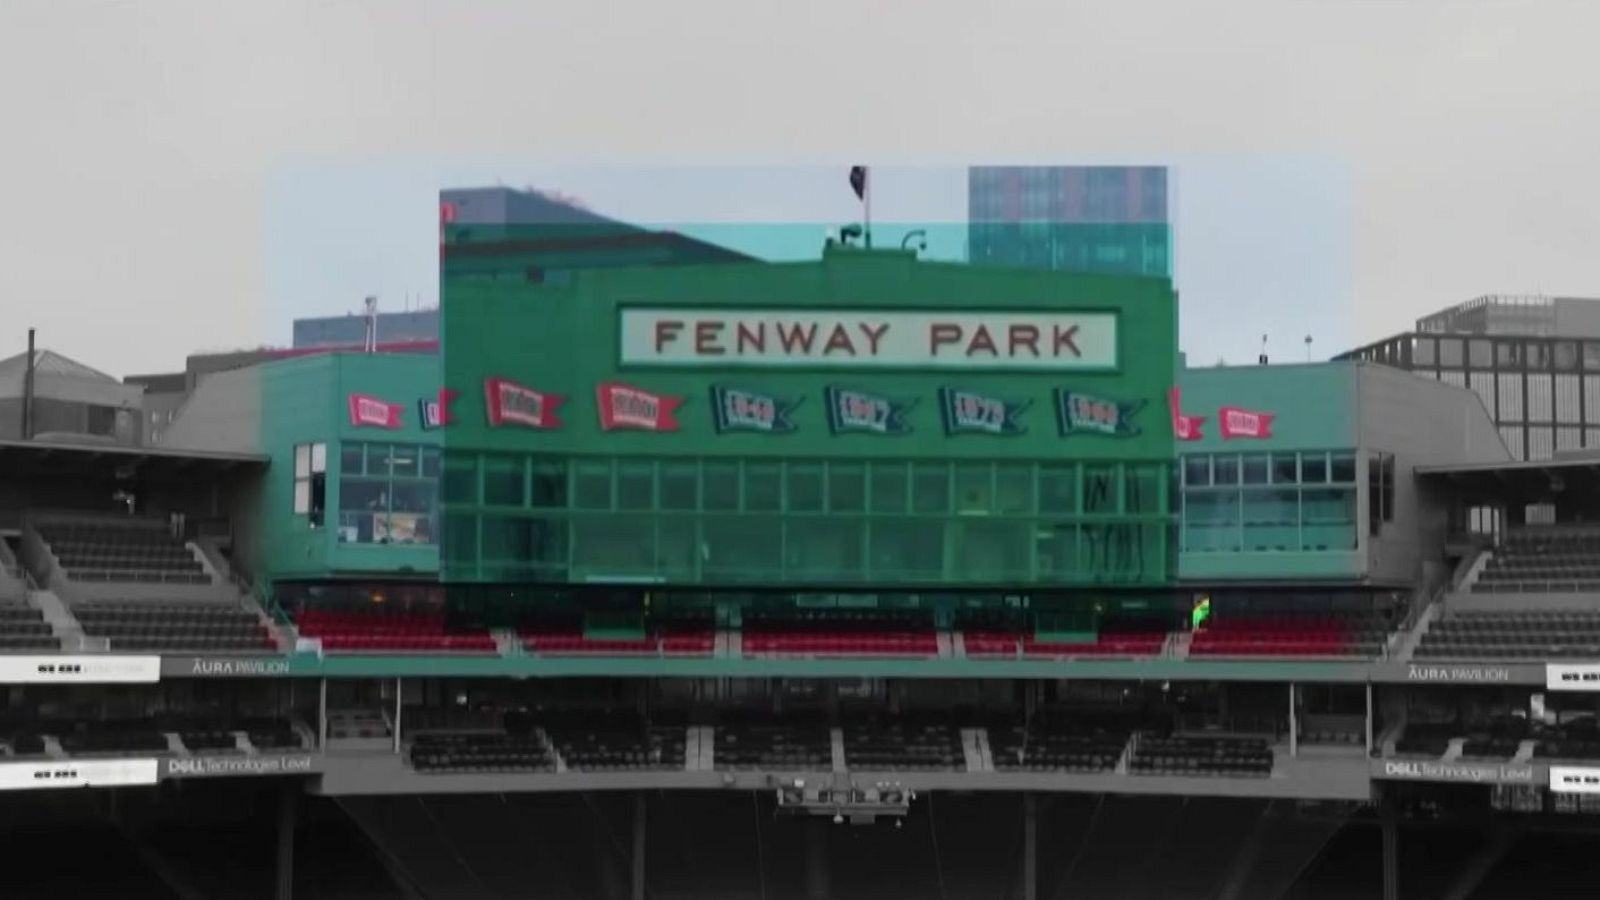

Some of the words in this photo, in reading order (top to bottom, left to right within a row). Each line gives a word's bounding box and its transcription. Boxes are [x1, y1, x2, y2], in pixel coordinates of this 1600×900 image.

[654, 320, 890, 356] FENWAY
[929, 322, 1083, 359] PARK
[235, 660, 290, 675] PAVILION
[1450, 667, 1509, 682] PAVILION
[280, 755, 311, 770] Level
[1500, 765, 1533, 780] Level
